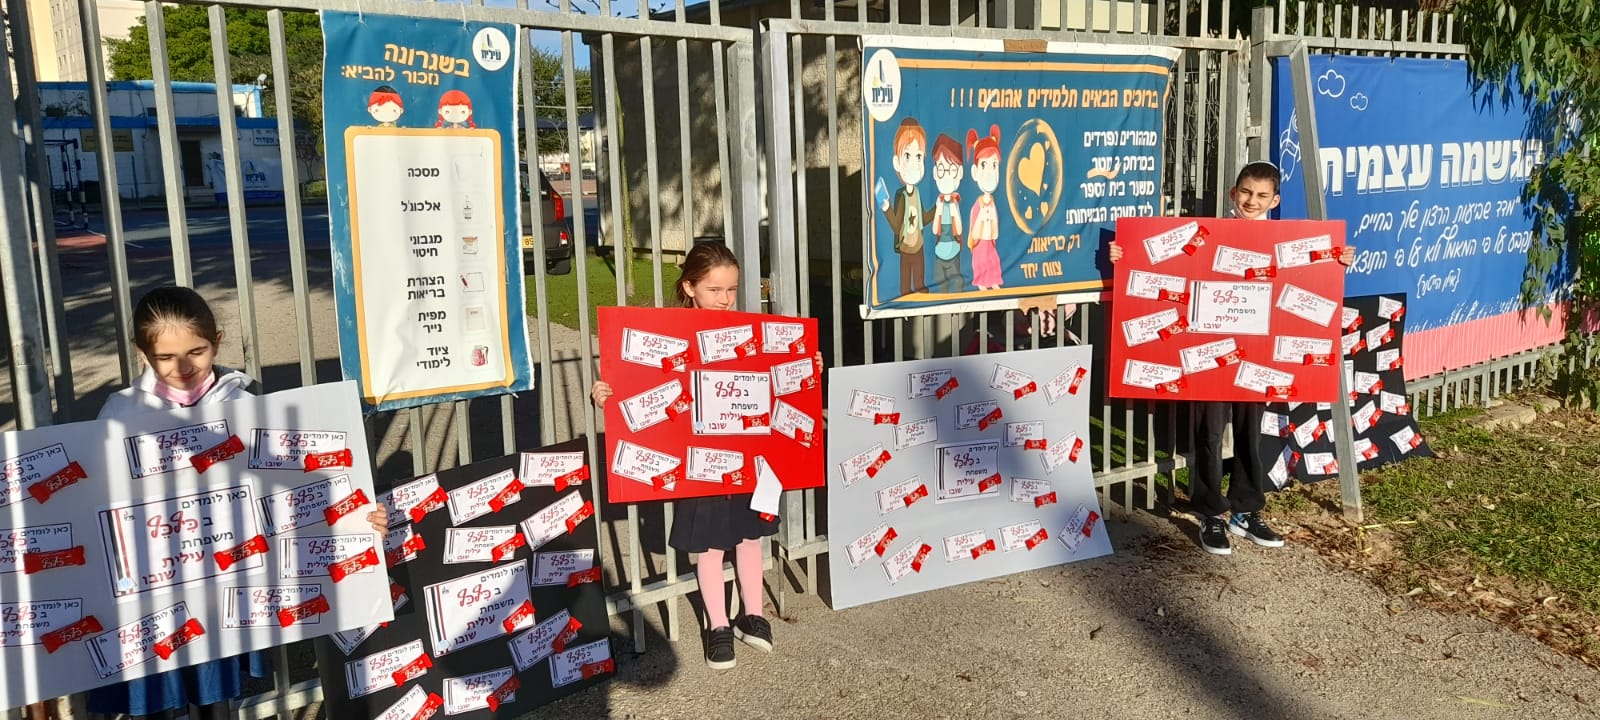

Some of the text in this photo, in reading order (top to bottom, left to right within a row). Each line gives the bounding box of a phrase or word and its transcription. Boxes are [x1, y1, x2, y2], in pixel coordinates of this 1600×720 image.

[384, 44, 470, 77] בשגרונה
[341, 65, 440, 85] נזכור להביא:
[978, 88, 1023, 109] אהובים
[1027, 85, 1078, 108] תלמידים
[1081, 89, 1118, 108] הבאים
[1123, 88, 1159, 109] ברוכים
[408, 168, 440, 177] מסכה
[1319, 143, 1433, 196] עצמית
[1109, 181, 1126, 197] בית
[1138, 201, 1154, 217] ליד
[1419, 205, 1450, 233] הרצון
[410, 234, 442, 245] מגבוני
[1067, 234, 1080, 254] רק
[1481, 237, 1492, 254] פי
[413, 247, 438, 257] חיטוי
[1394, 249, 1405, 267] פי
[407, 275, 444, 287] הצהרת
[407, 288, 445, 300] בריאות
[418, 310, 446, 321] מפית
[423, 323, 442, 333] נייר
[426, 345, 449, 356] ציוד
[416, 356, 451, 369] לימודי
[733, 374, 769, 383] כאן לומדים
[731, 402, 759, 410] משפחת
[720, 412, 743, 421] עילית
[708, 422, 727, 430] שובו
[181, 490, 247, 509] כאן לומדים
[203, 516, 213, 526] ב
[181, 531, 233, 549] משפחת
[161, 551, 205, 567] עילית
[142, 569, 176, 584] שובו
[480, 565, 524, 583] כאן לומדים
[494, 587, 501, 595] ב
[480, 598, 514, 614] משפחת
[466, 615, 496, 630] עילית
[454, 631, 477, 645] שובו
